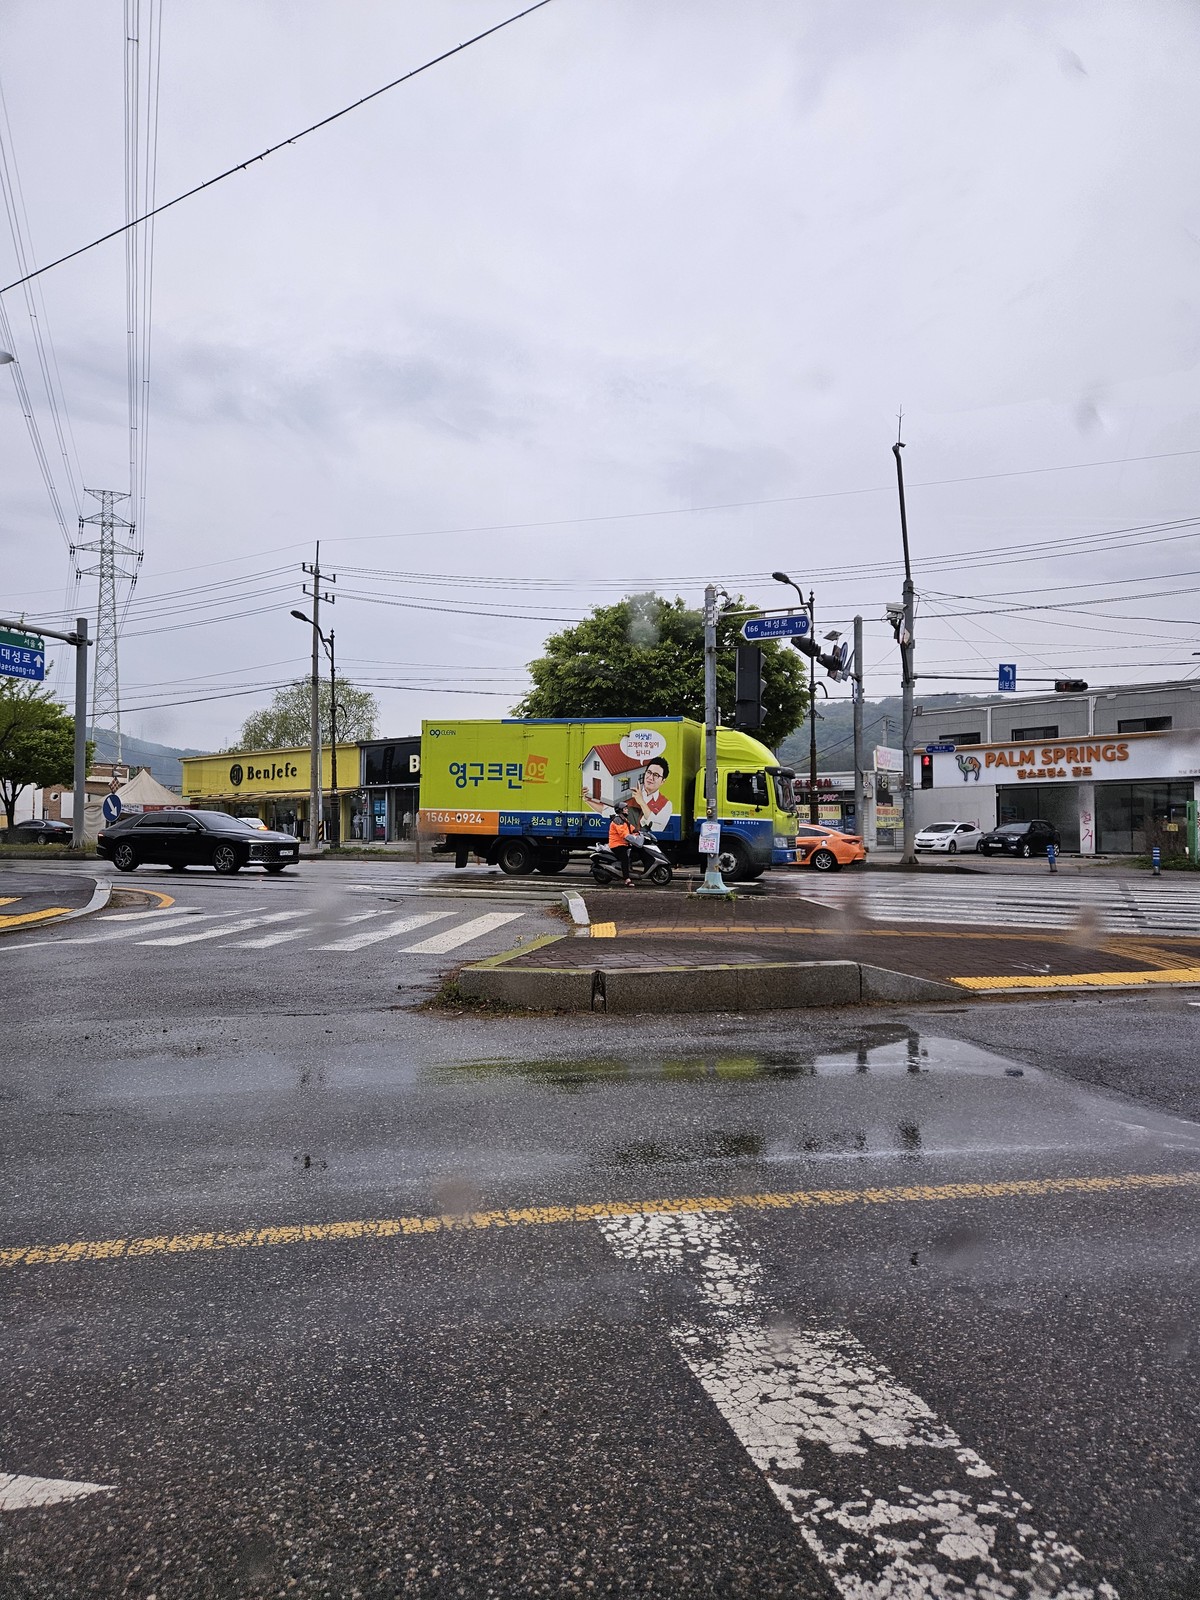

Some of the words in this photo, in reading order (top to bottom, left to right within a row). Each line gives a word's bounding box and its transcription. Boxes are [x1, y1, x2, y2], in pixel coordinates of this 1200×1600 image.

[747, 625, 759, 633] 166
[764, 619, 788, 629] 대성로
[795, 620, 807, 628] 170
[760, 629, 793, 637] Daeseong-ro
[24, 638, 36, 648] 서울
[1, 648, 31, 664] 대성로
[0, 662, 36, 675] aeseong-ro
[999, 680, 1016, 690] 비보호
[429, 729, 441, 738] 09
[627, 741, 643, 749] 고객의
[644, 741, 660, 749] 휴일이
[985, 750, 1036, 768] PALM
[1041, 743, 1130, 766] SPRINGS
[247, 762, 298, 780] BenJefe
[449, 762, 523, 789] 영구크린
[527, 762, 547, 777] 09
[1071, 766, 1093, 778] 골프
[426, 811, 482, 824] 1566-0924
[499, 815, 520, 825] 이사와
[531, 815, 553, 826] 청소를
[555, 816, 563, 826] 한
